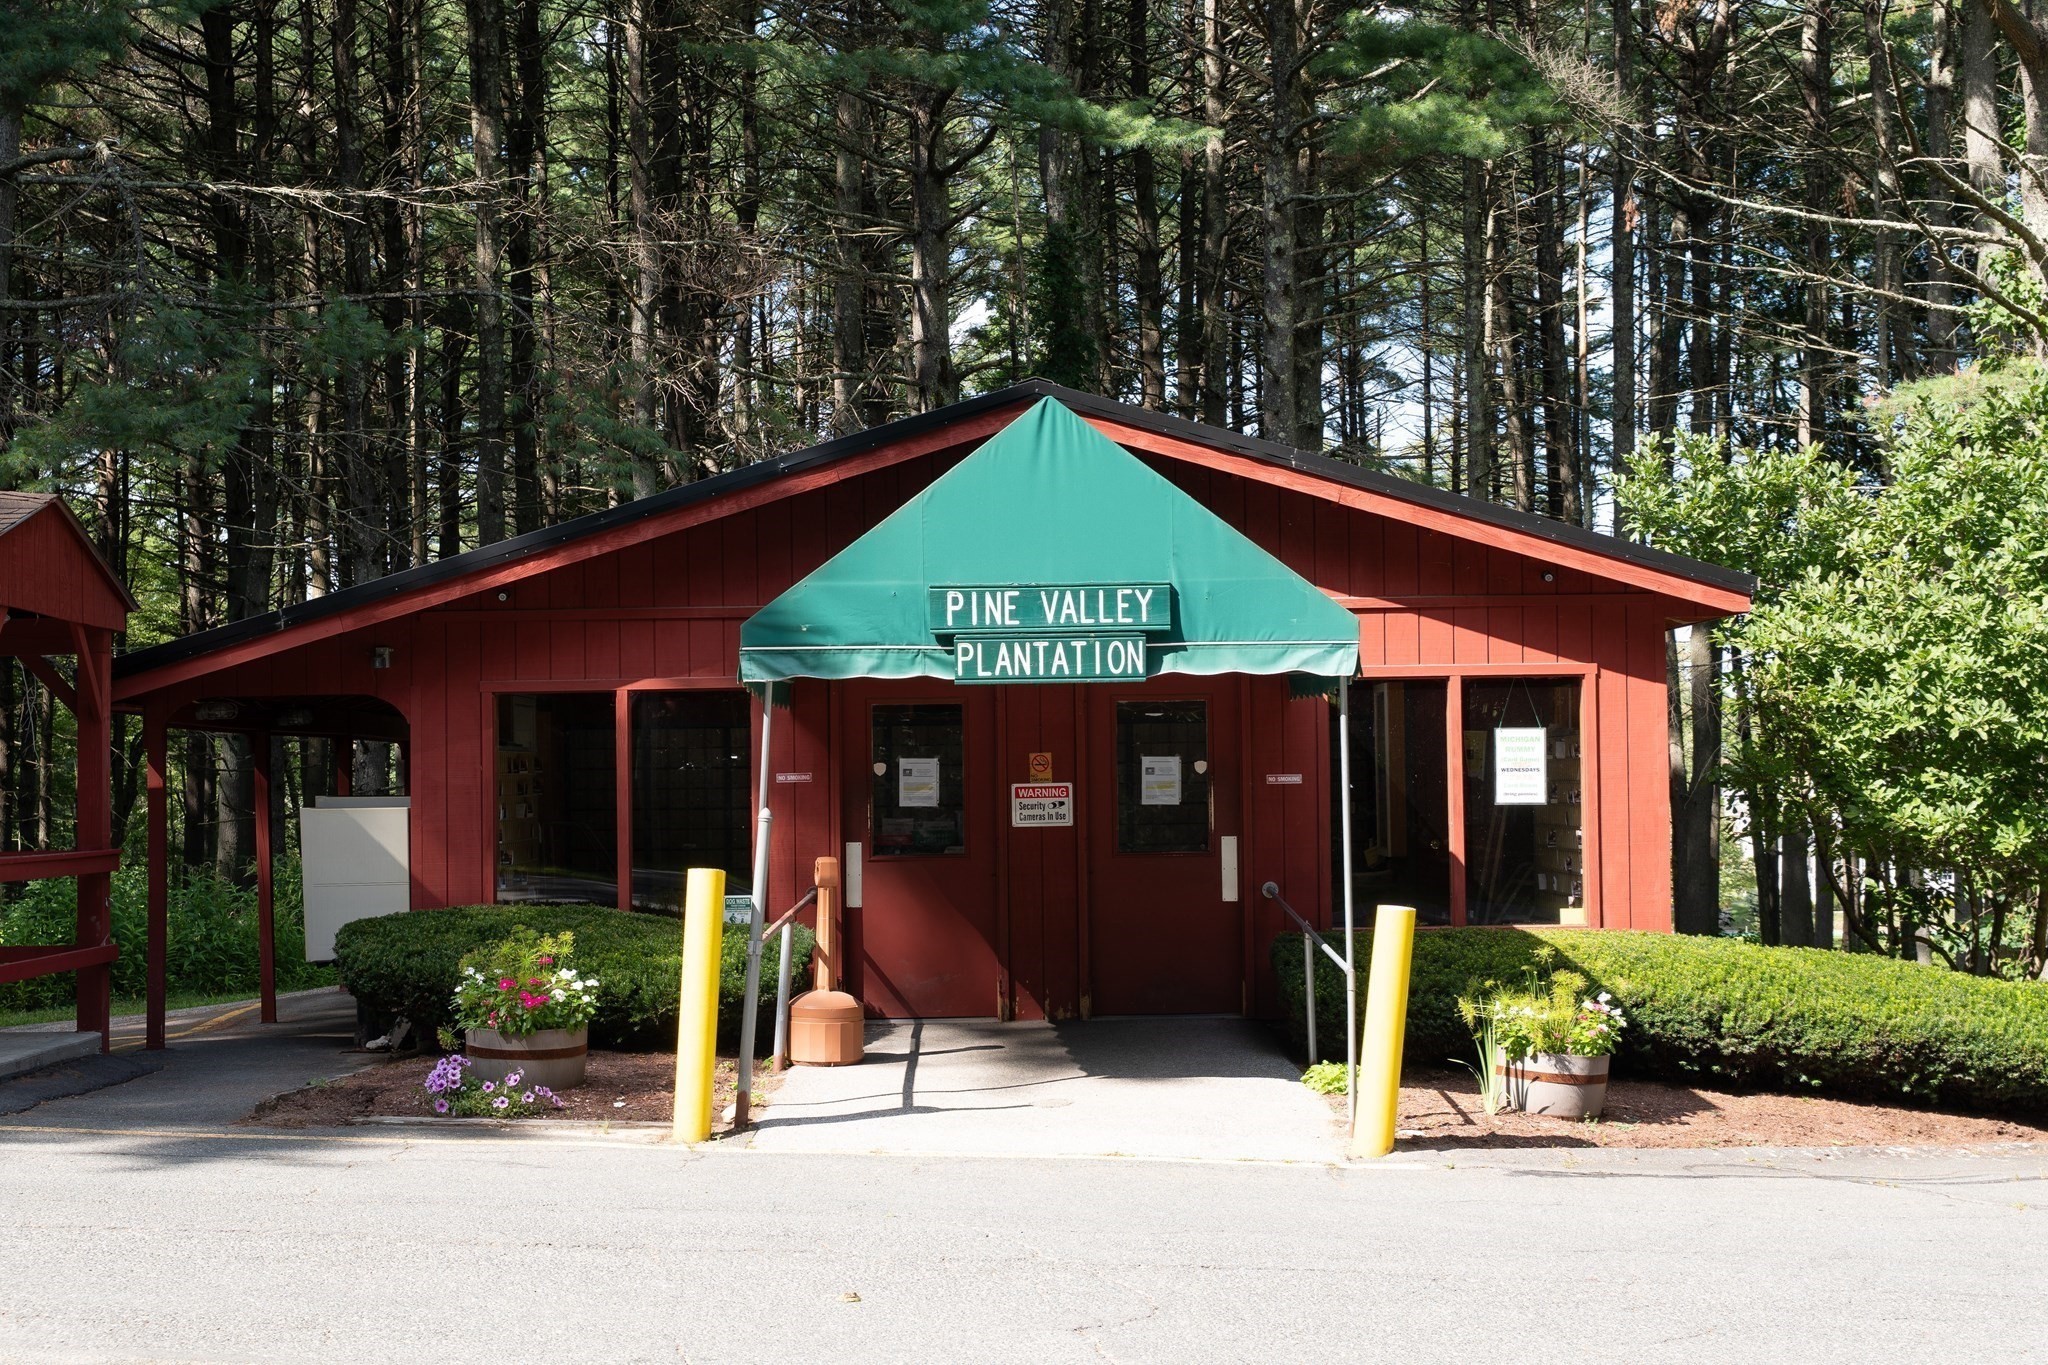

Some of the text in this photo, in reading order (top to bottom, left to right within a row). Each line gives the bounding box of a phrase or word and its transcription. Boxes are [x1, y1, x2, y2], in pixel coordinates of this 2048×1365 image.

[946, 589, 1153, 626] PINE VALLEY
[957, 640, 1144, 677] PLANTATION
[1018, 788, 1067, 797] WARNING
[1018, 801, 1046, 812] Security
[1019, 811, 1067, 822] Cameras In Use
